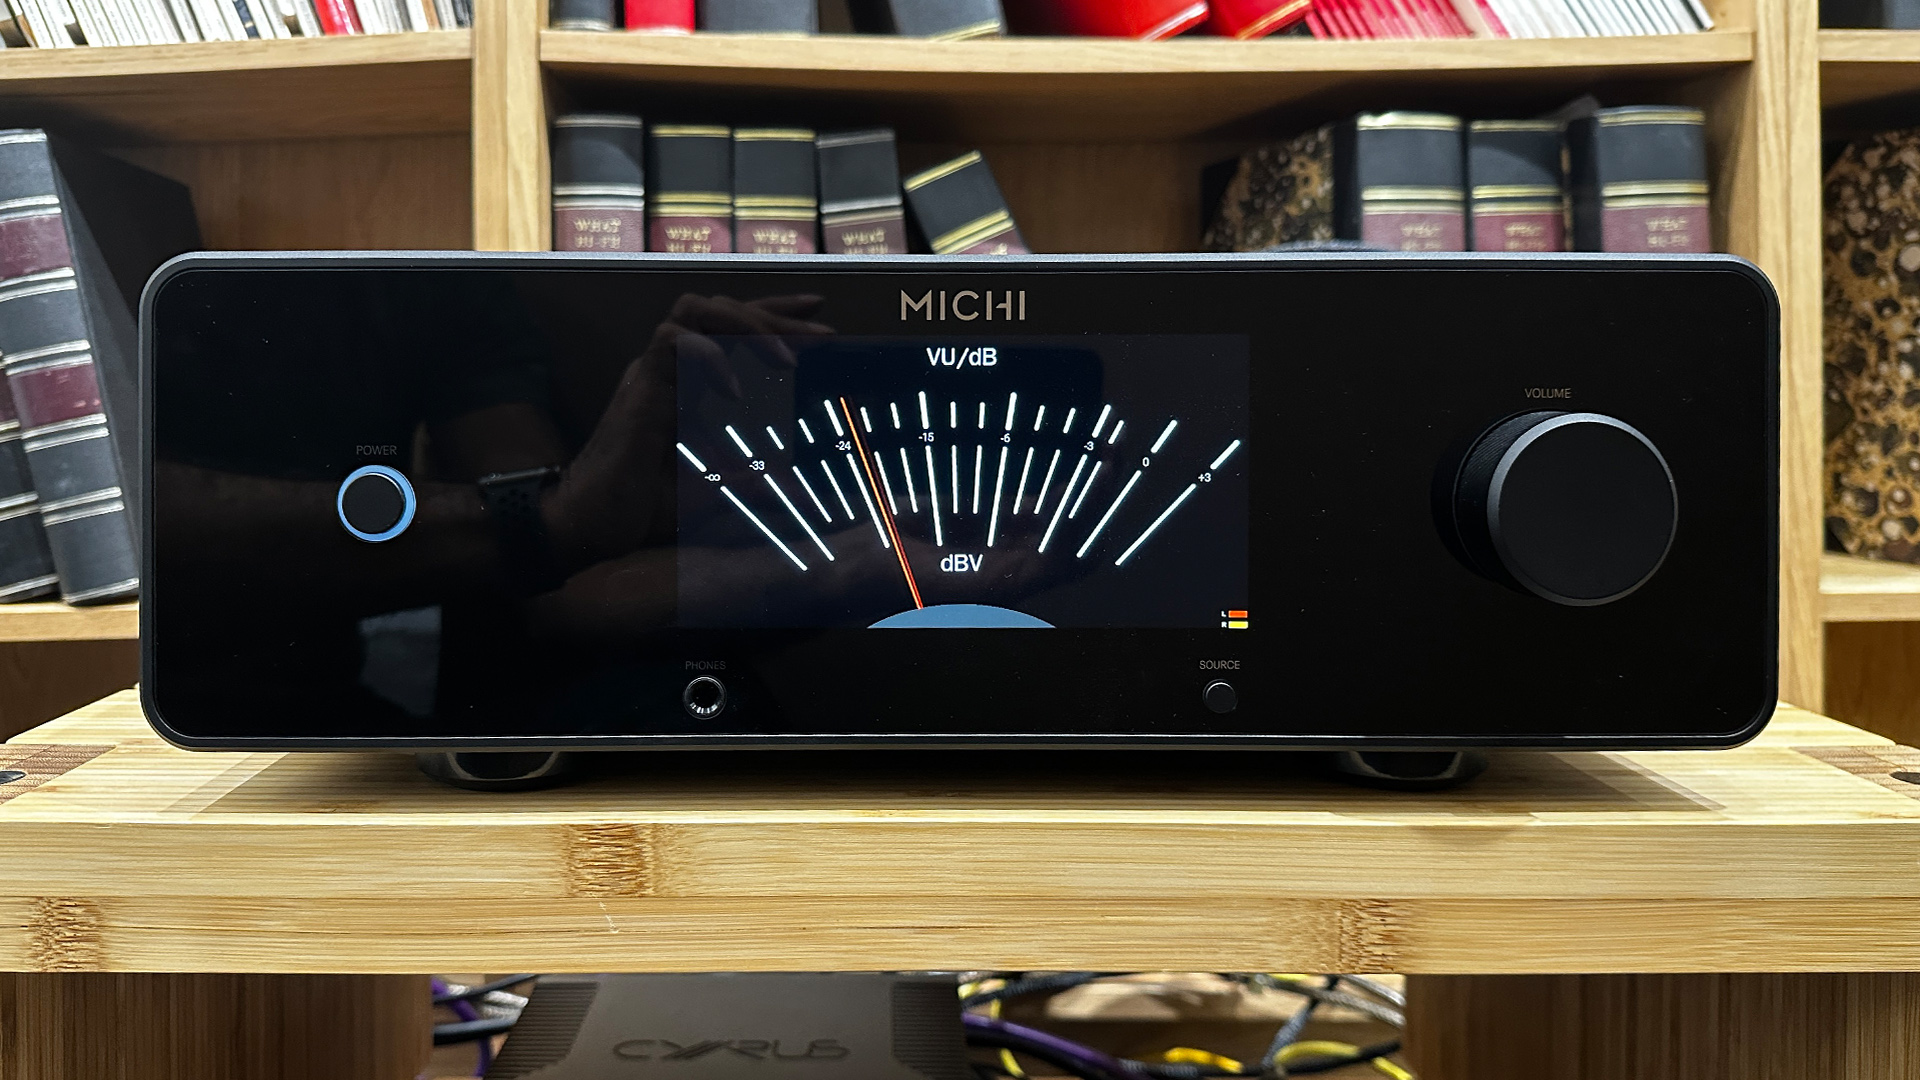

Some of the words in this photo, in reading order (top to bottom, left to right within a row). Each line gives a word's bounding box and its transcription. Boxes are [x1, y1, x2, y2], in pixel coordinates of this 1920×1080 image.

[900, 289, 1026, 322] MICHI
[926, 346, 998, 370] VU/dB
[1524, 387, 1572, 399] VOLUME
[918, 432, 935, 442] -15
[1000, 433, 1011, 443] -6
[356, 445, 397, 456] POWER
[835, 441, 852, 451] -24
[1083, 441, 1094, 451] -3
[749, 460, 765, 471] -33
[1142, 457, 1150, 467] 0
[1197, 472, 1212, 482] +3
[940, 553, 984, 573] dBV
[685, 660, 726, 670] PHONES
[1199, 660, 1241, 670] SOURCE
